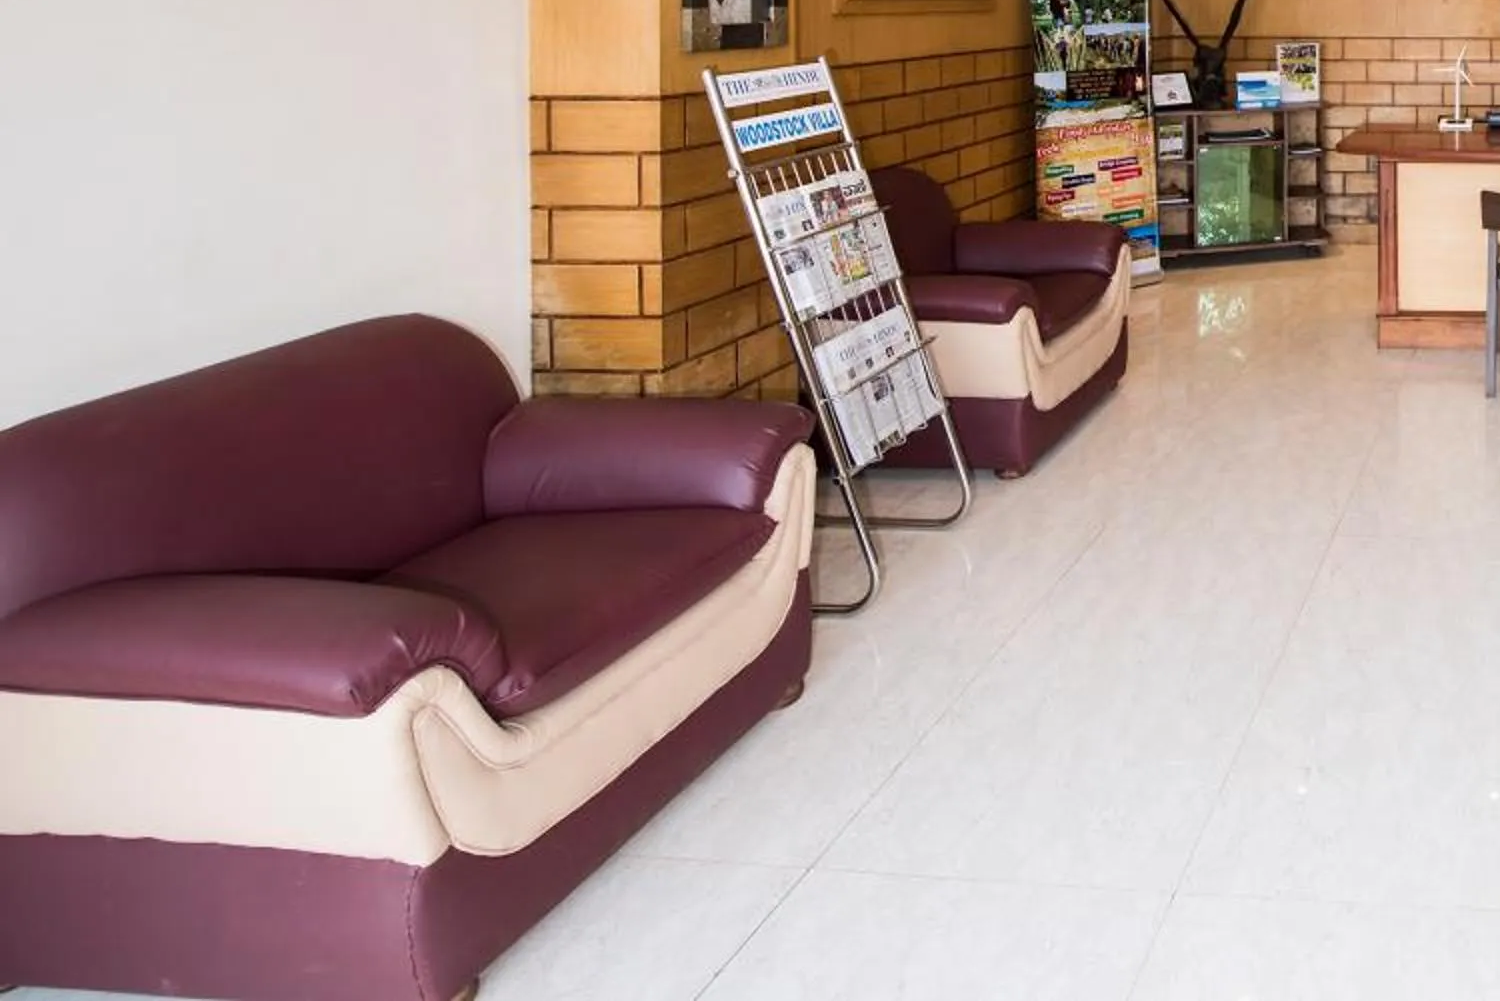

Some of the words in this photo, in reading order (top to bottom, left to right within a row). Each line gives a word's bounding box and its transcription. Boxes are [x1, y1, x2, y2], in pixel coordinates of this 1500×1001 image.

[722, 77, 752, 97] THE
[735, 113, 810, 147] WOODSTOCK
[808, 108, 839, 132] VILLA
